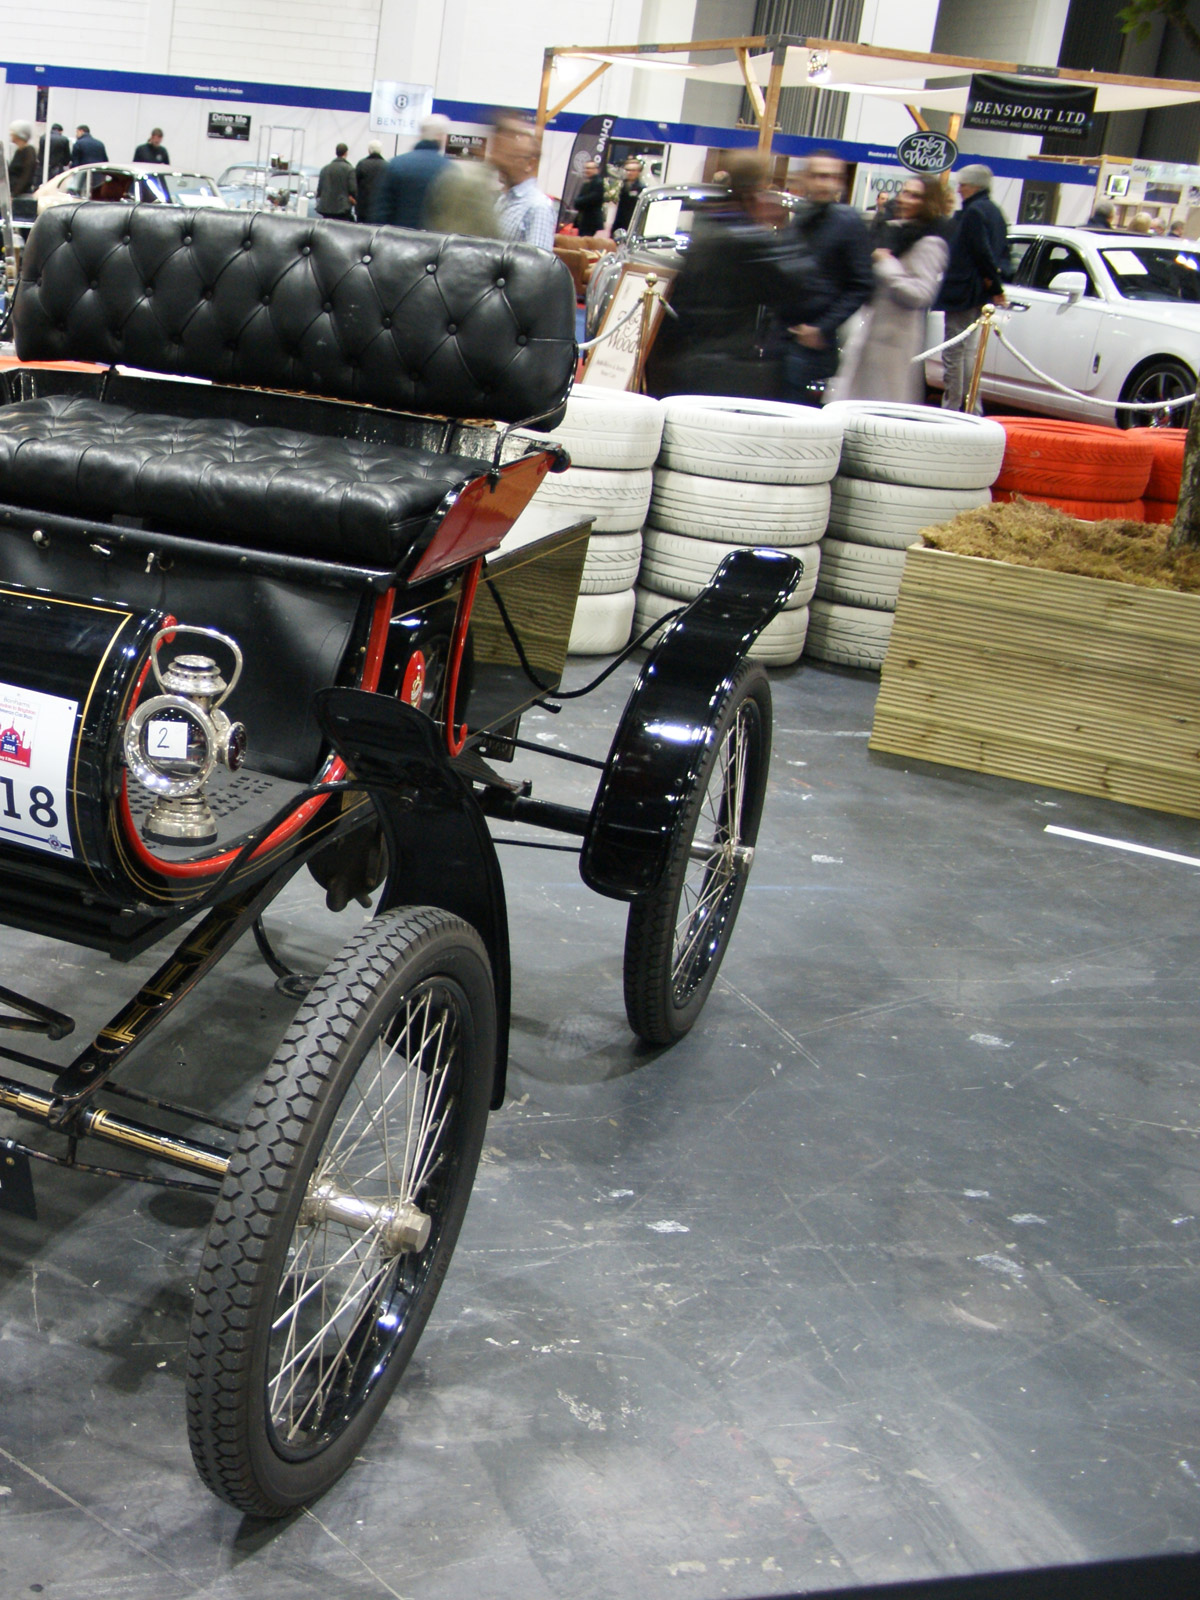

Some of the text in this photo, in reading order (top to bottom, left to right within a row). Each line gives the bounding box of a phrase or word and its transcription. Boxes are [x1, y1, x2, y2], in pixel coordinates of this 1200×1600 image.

[212, 112, 234, 122] Drive
[973, 101, 1086, 124] BENSPORT LTD
[597, 118, 614, 152] Drive
[1022, 122, 1048, 131] BENTLEY
[450, 134, 471, 145] Drive
[904, 150, 947, 168] Wood
[157, 727, 169, 749] 2
